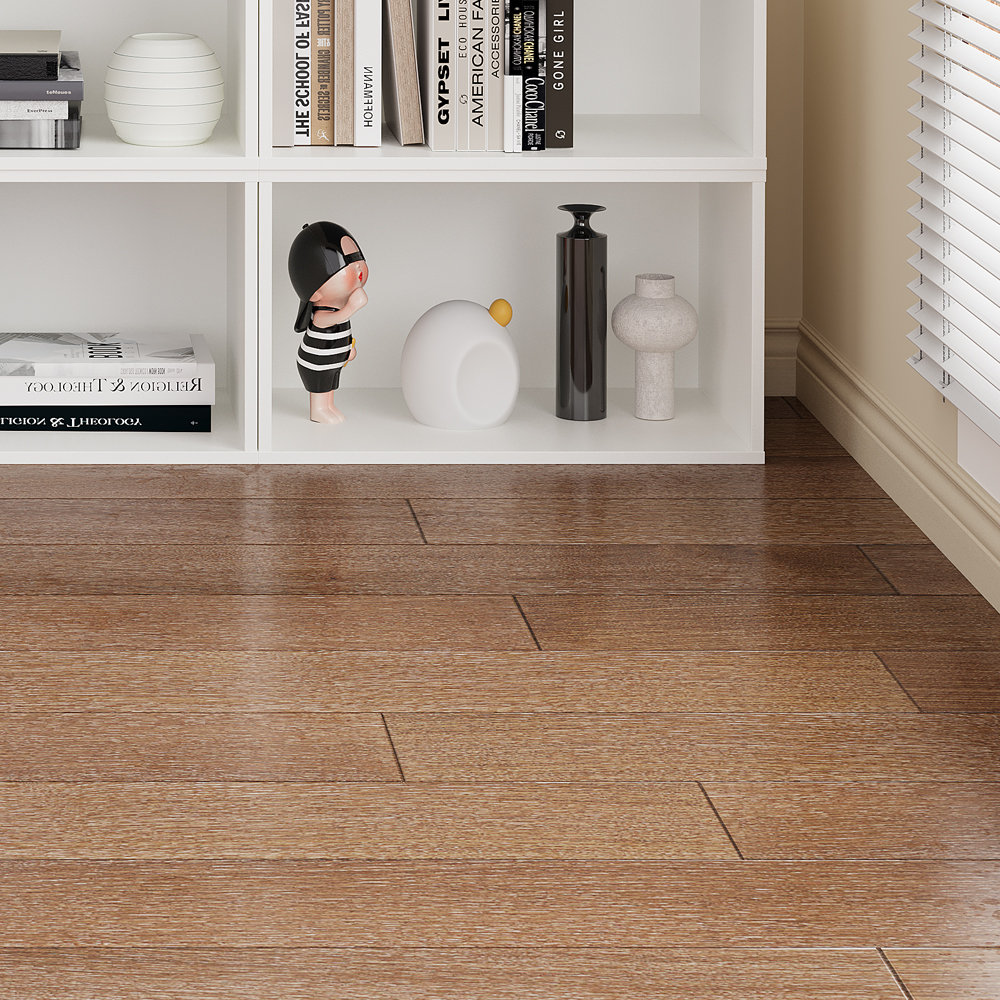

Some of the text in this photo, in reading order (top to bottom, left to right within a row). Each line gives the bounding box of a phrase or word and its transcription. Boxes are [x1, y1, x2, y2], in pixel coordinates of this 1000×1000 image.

[438, 38, 450, 125] GYPSET
[459, 38, 467, 58] ECO
[472, 27, 484, 127] AMERICAN
[553, 11, 565, 91] GONE GIRL
